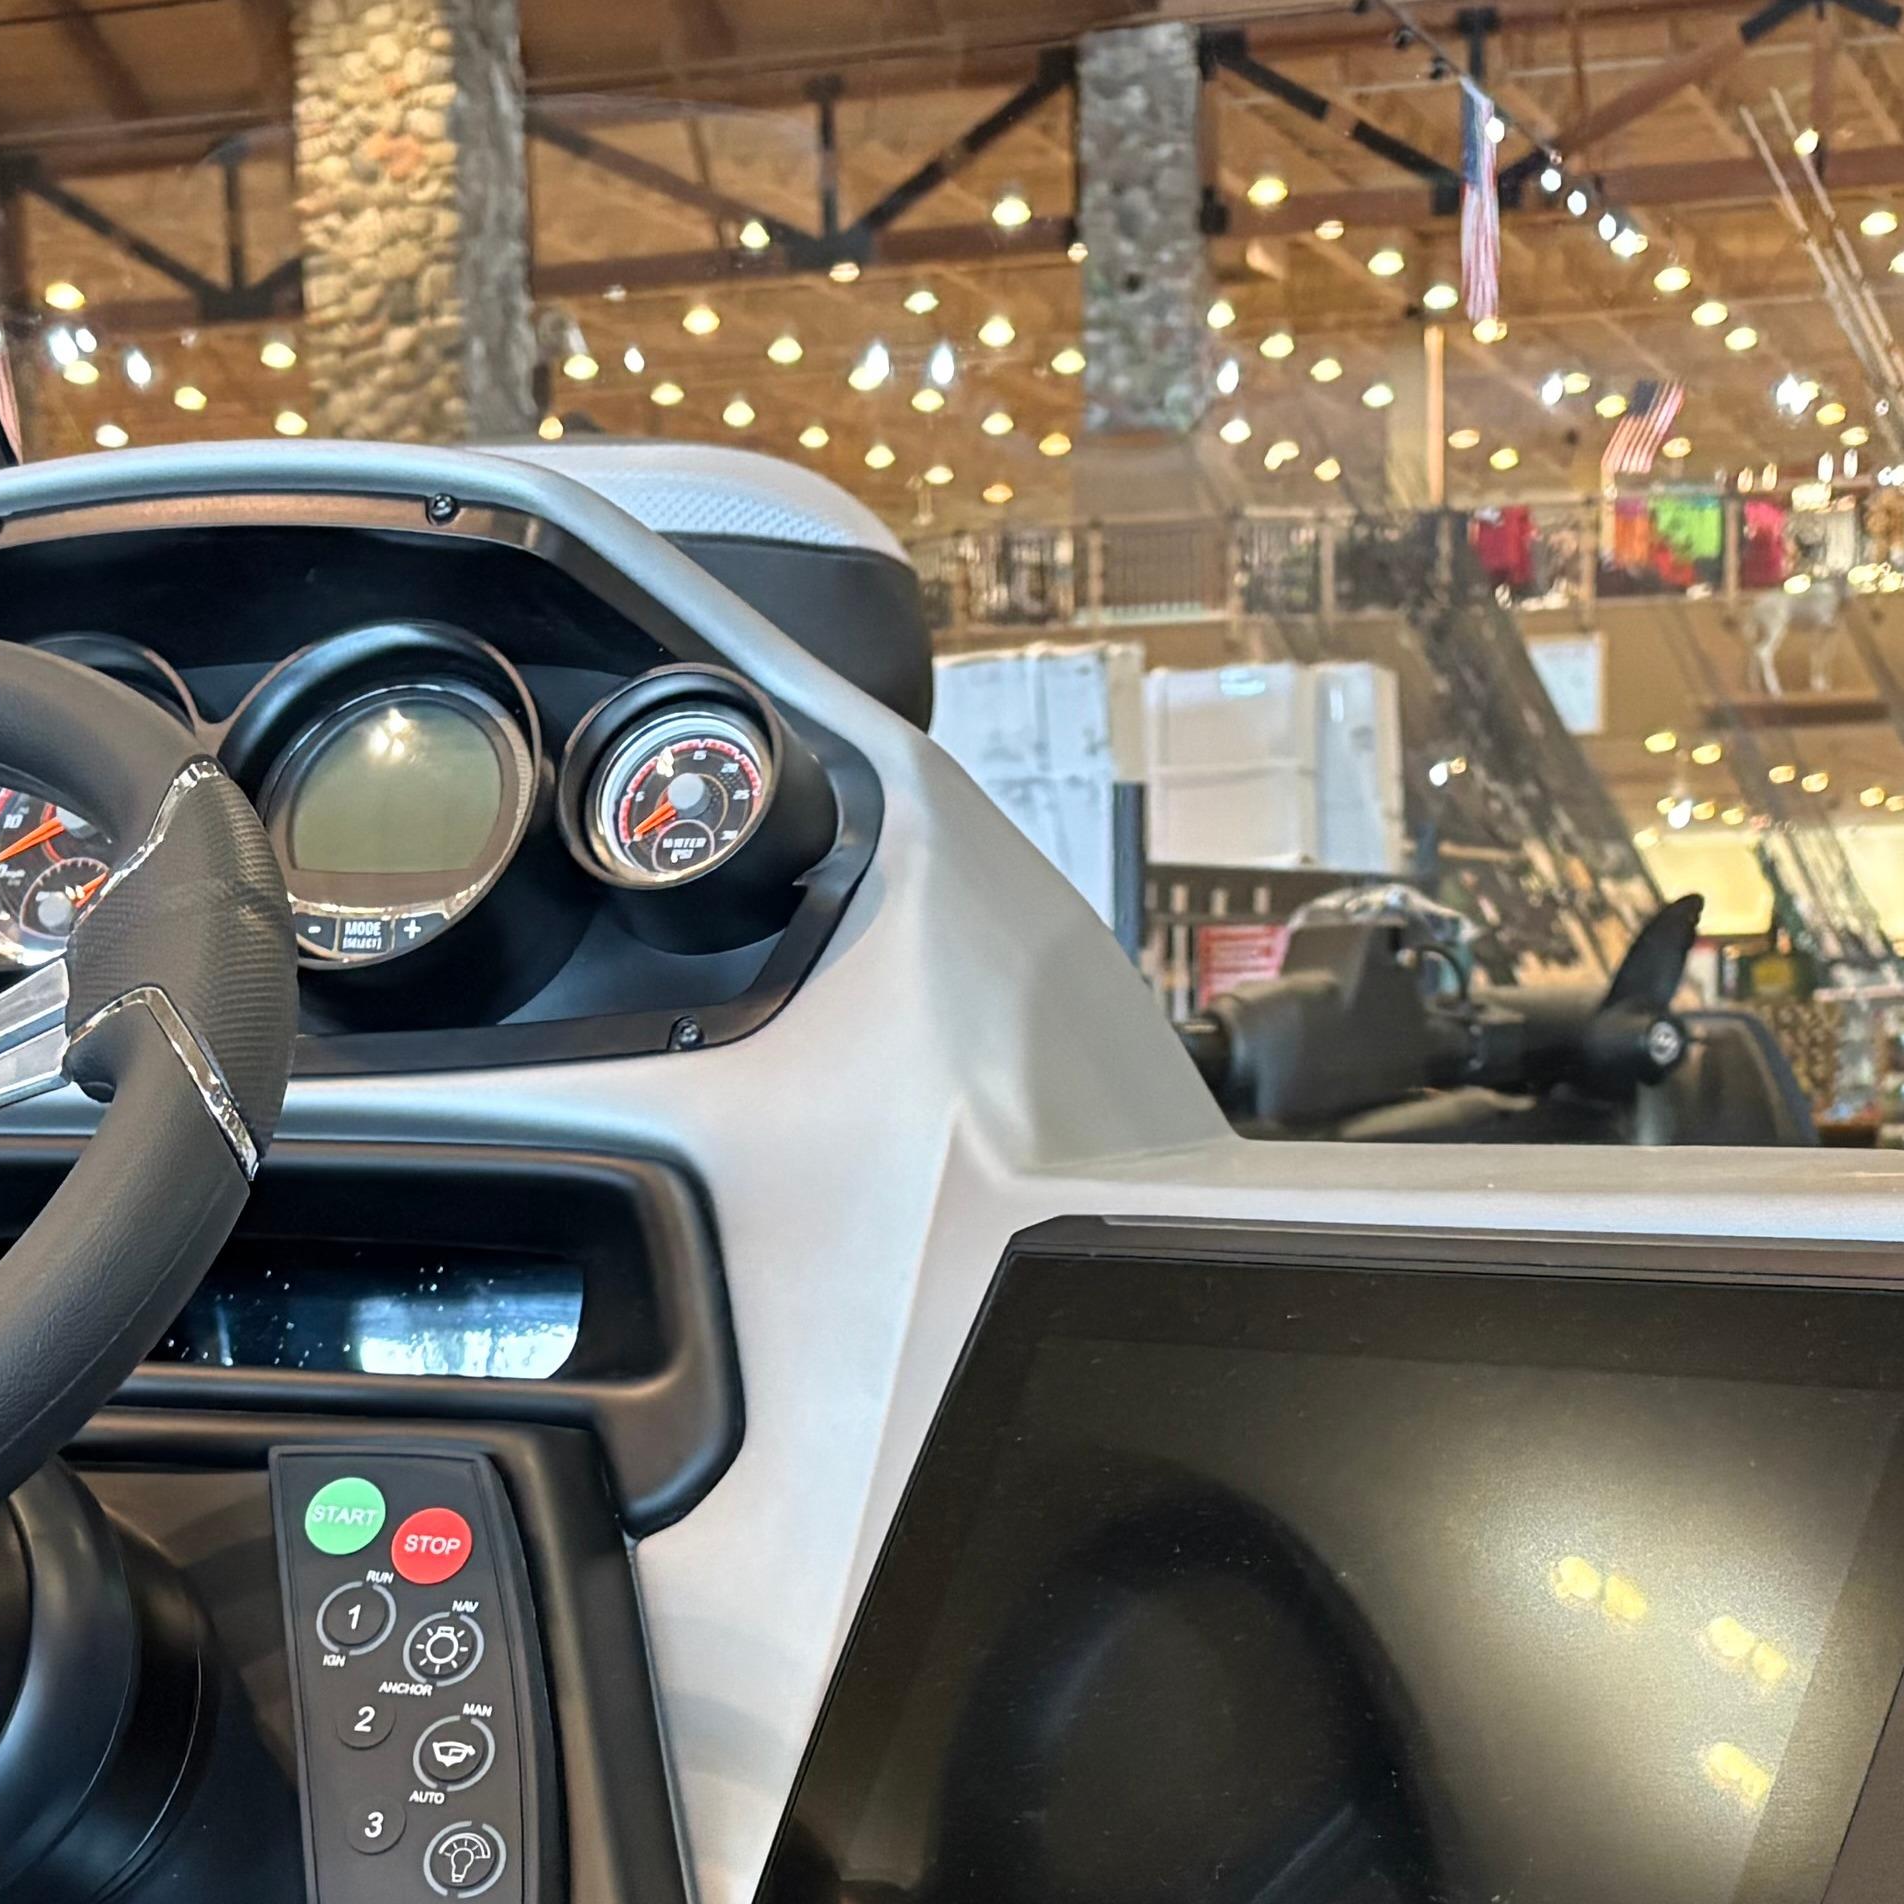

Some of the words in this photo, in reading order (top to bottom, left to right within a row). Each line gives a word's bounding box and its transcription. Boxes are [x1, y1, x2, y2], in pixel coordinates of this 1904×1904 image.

[3, 814, 24, 828] 10
[344, 921, 382, 936] MODE
[311, 1504, 378, 1527] START
[404, 1534, 462, 1555] STOP
[365, 1569, 395, 1585] RUN
[451, 1600, 480, 1614] NAV
[348, 1603, 362, 1630] 1
[378, 1681, 434, 1697] ANCHOR
[462, 1702, 493, 1718] MAN
[353, 1705, 376, 1733] 2
[408, 1790, 446, 1806] AUTO
[364, 1811, 384, 1838] 3
